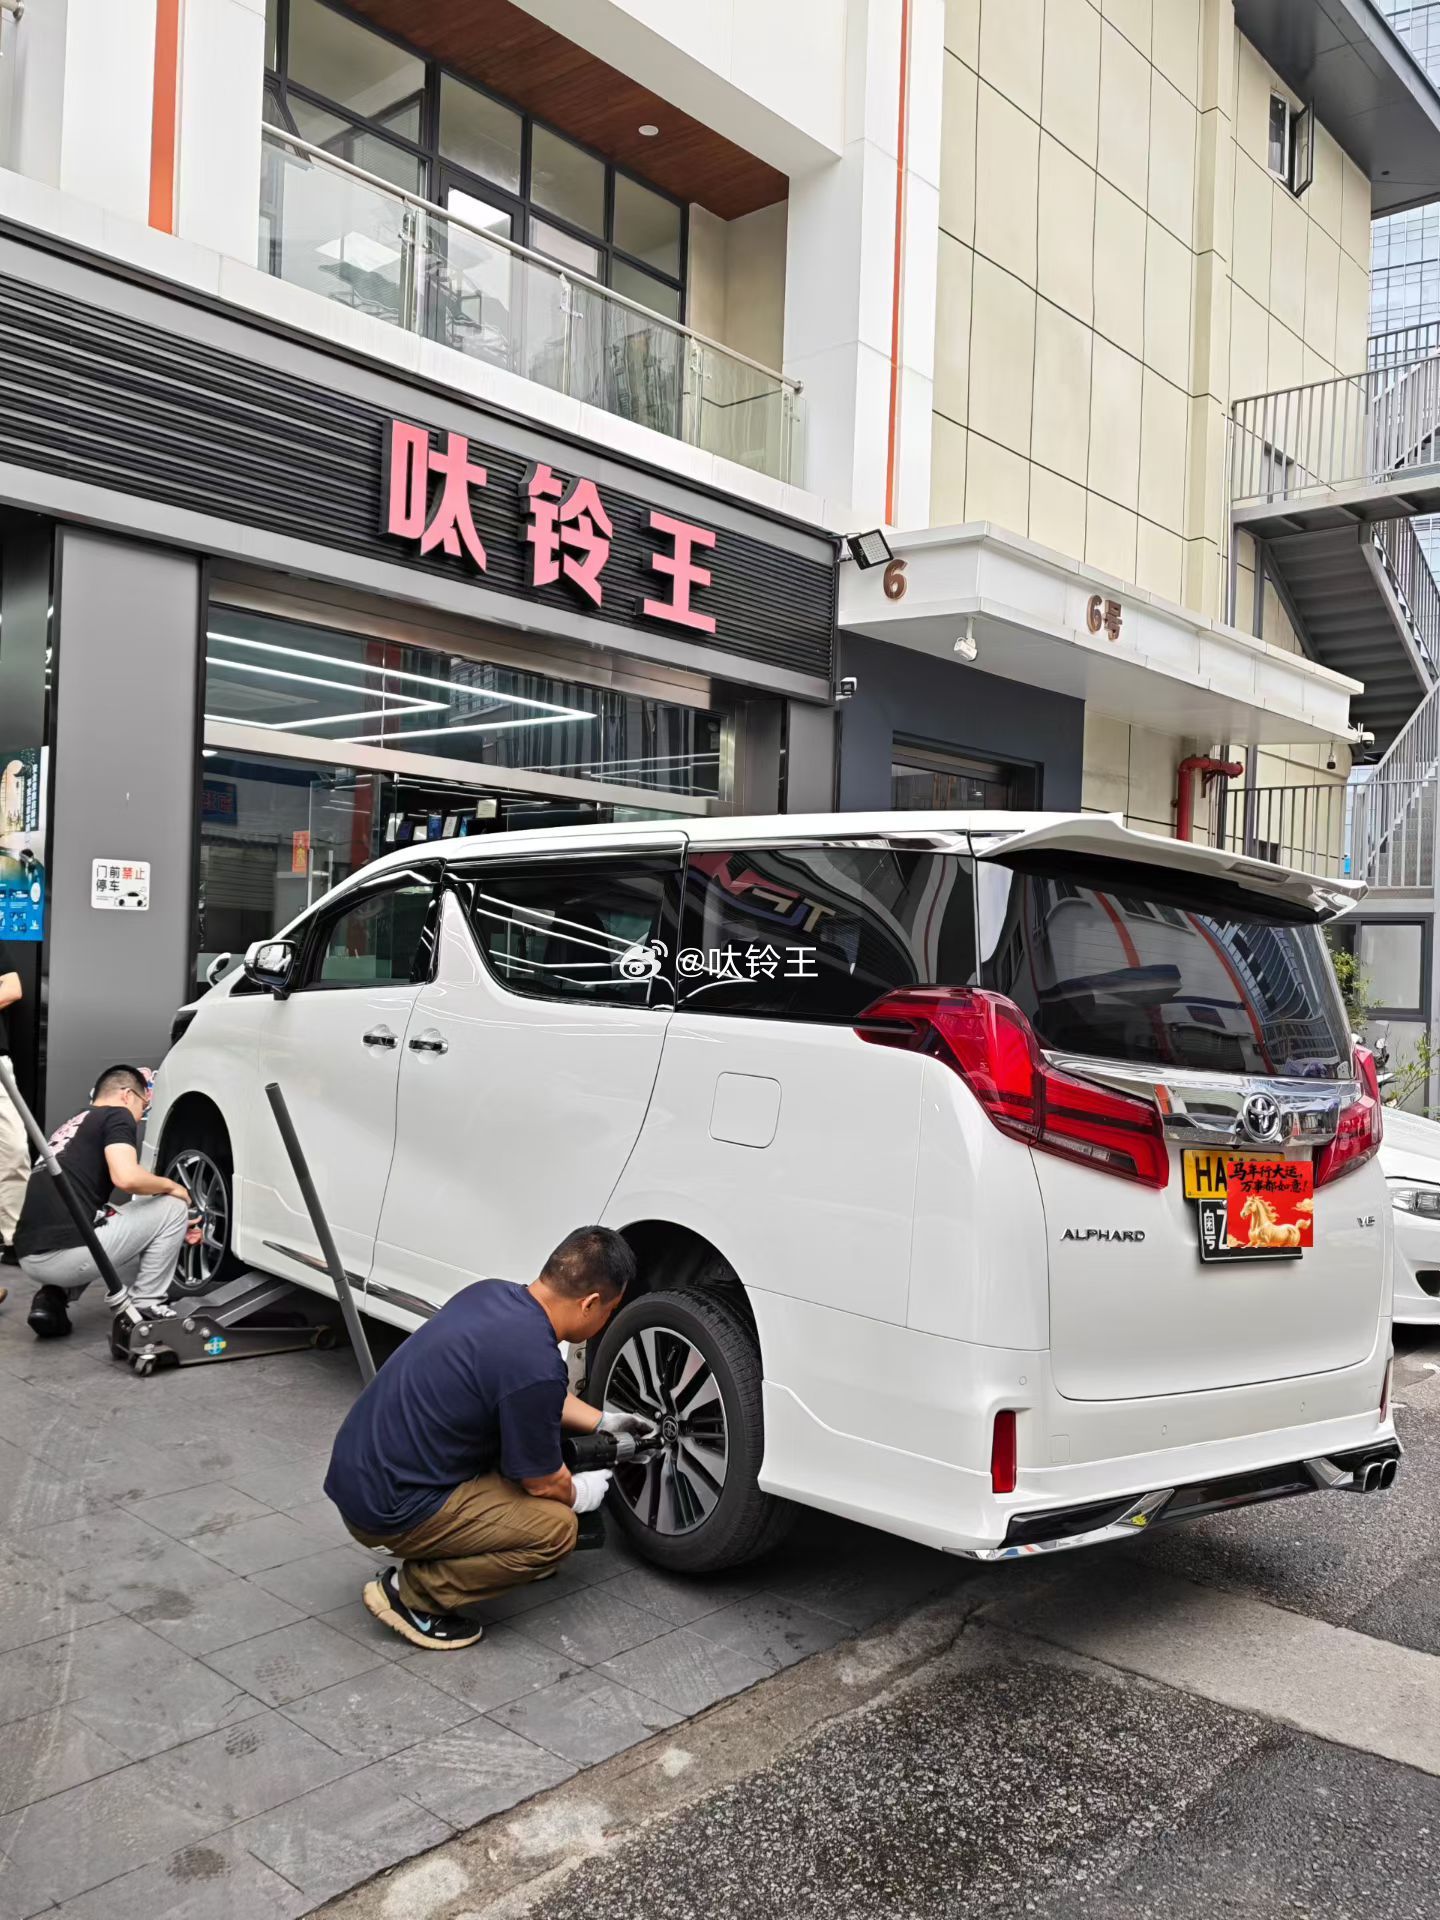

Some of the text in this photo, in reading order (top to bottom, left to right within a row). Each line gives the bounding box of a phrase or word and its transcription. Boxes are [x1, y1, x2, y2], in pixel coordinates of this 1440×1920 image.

[383, 418, 717, 634] 呔铃王
[883, 558, 908, 600] 6
[1086, 594, 1123, 641] 6号
[96, 879, 120, 892] 停车
[1060, 1228, 1146, 1242] ALPHARD
